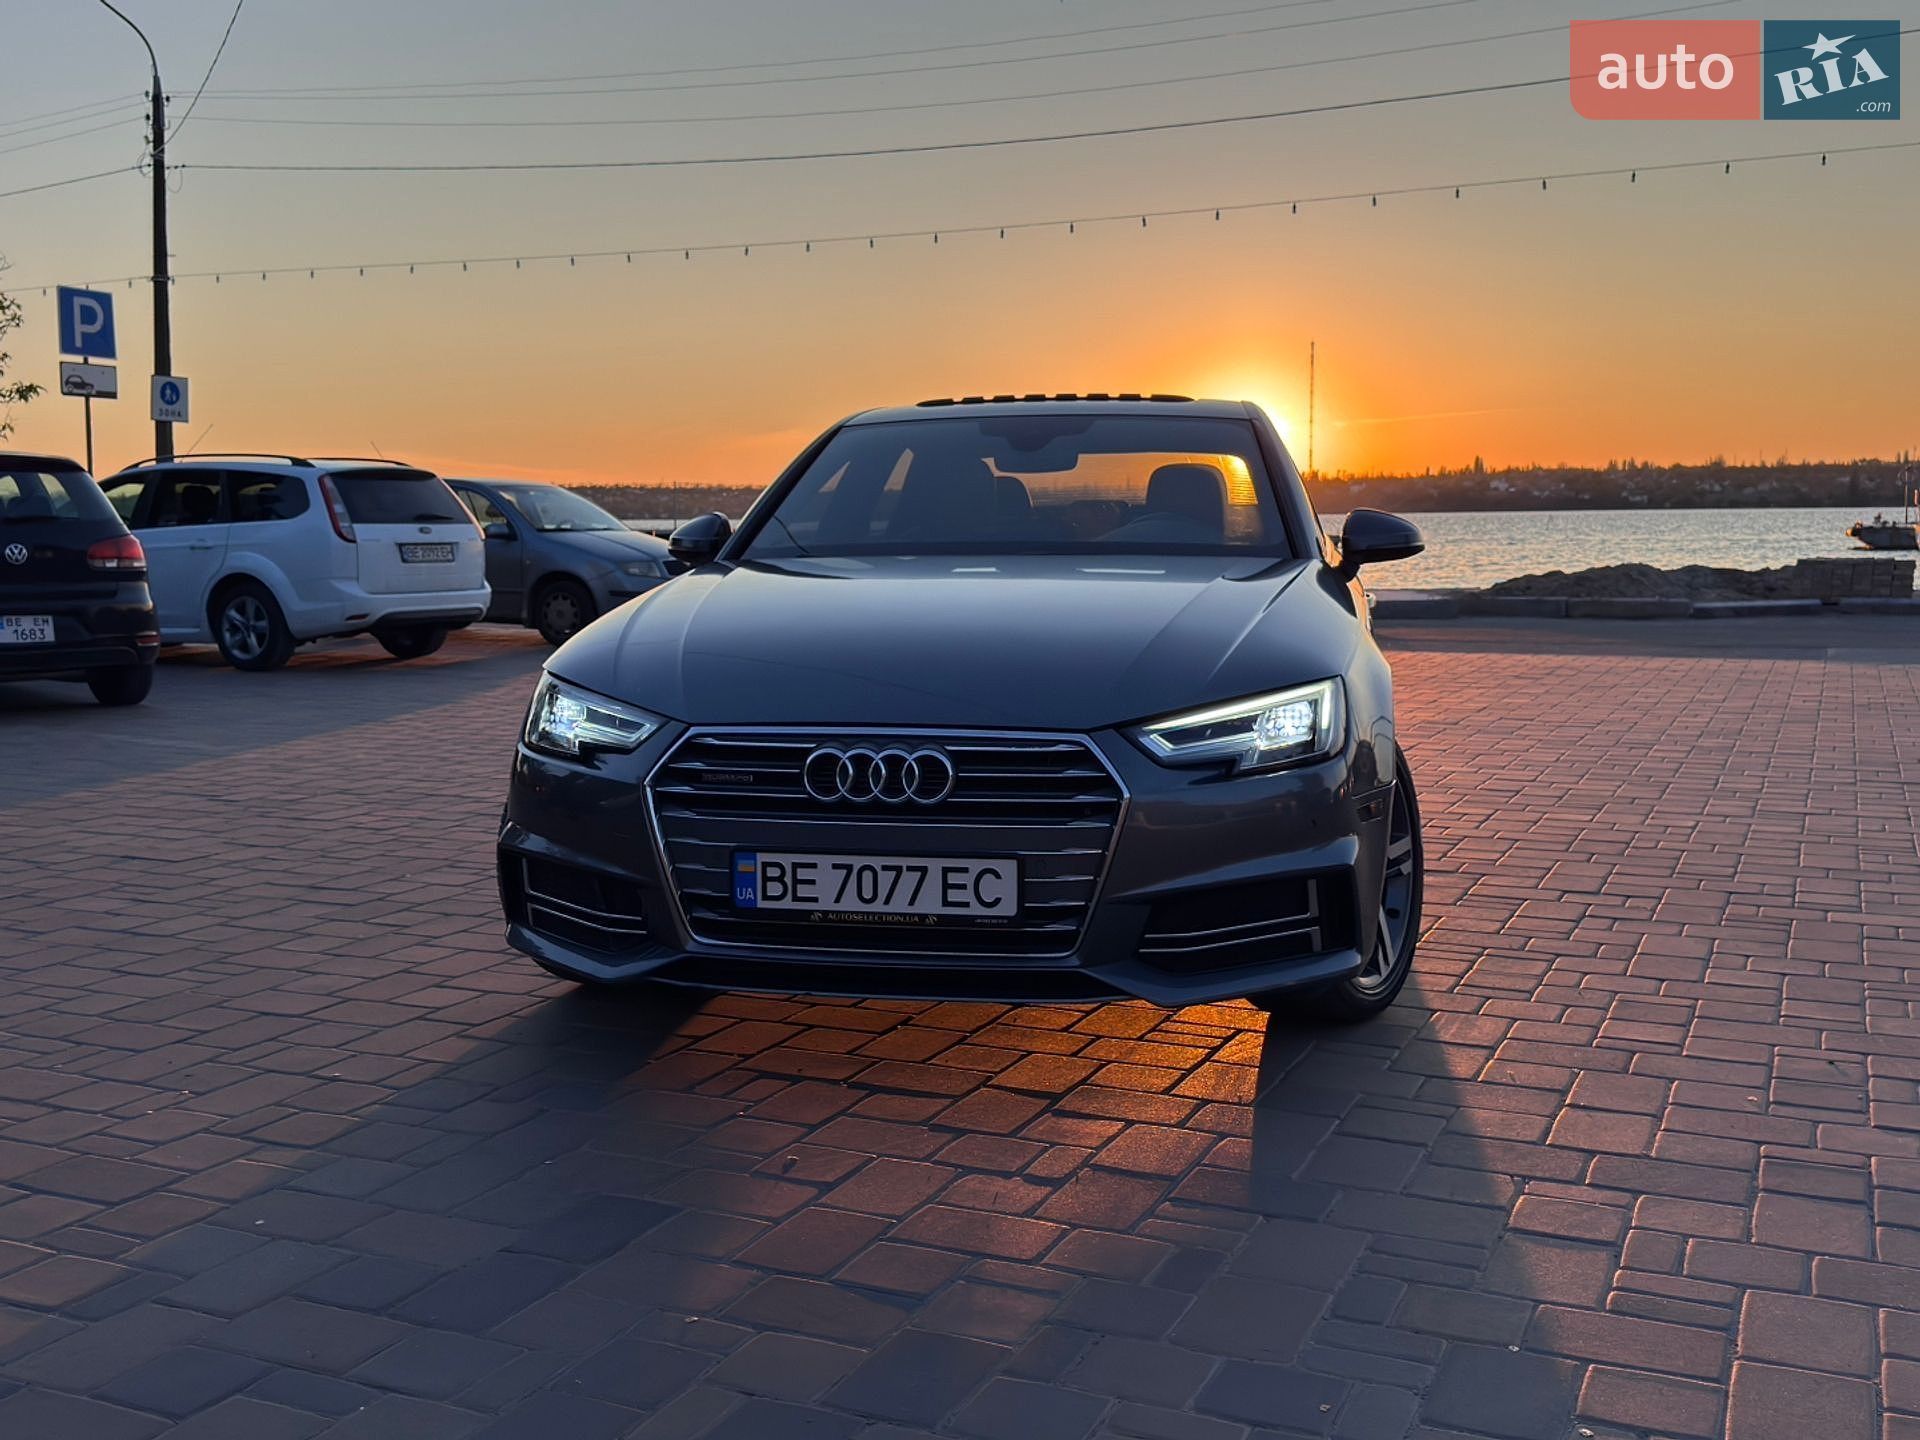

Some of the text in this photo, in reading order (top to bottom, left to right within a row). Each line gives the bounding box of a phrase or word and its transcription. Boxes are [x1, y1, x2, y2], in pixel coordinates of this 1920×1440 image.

[73, 296, 104, 348] P
[6, 617, 22, 627] BE
[12, 628, 46, 640] 1683
[761, 861, 1003, 909] BE 7077 EC
[737, 887, 755, 900] UA
